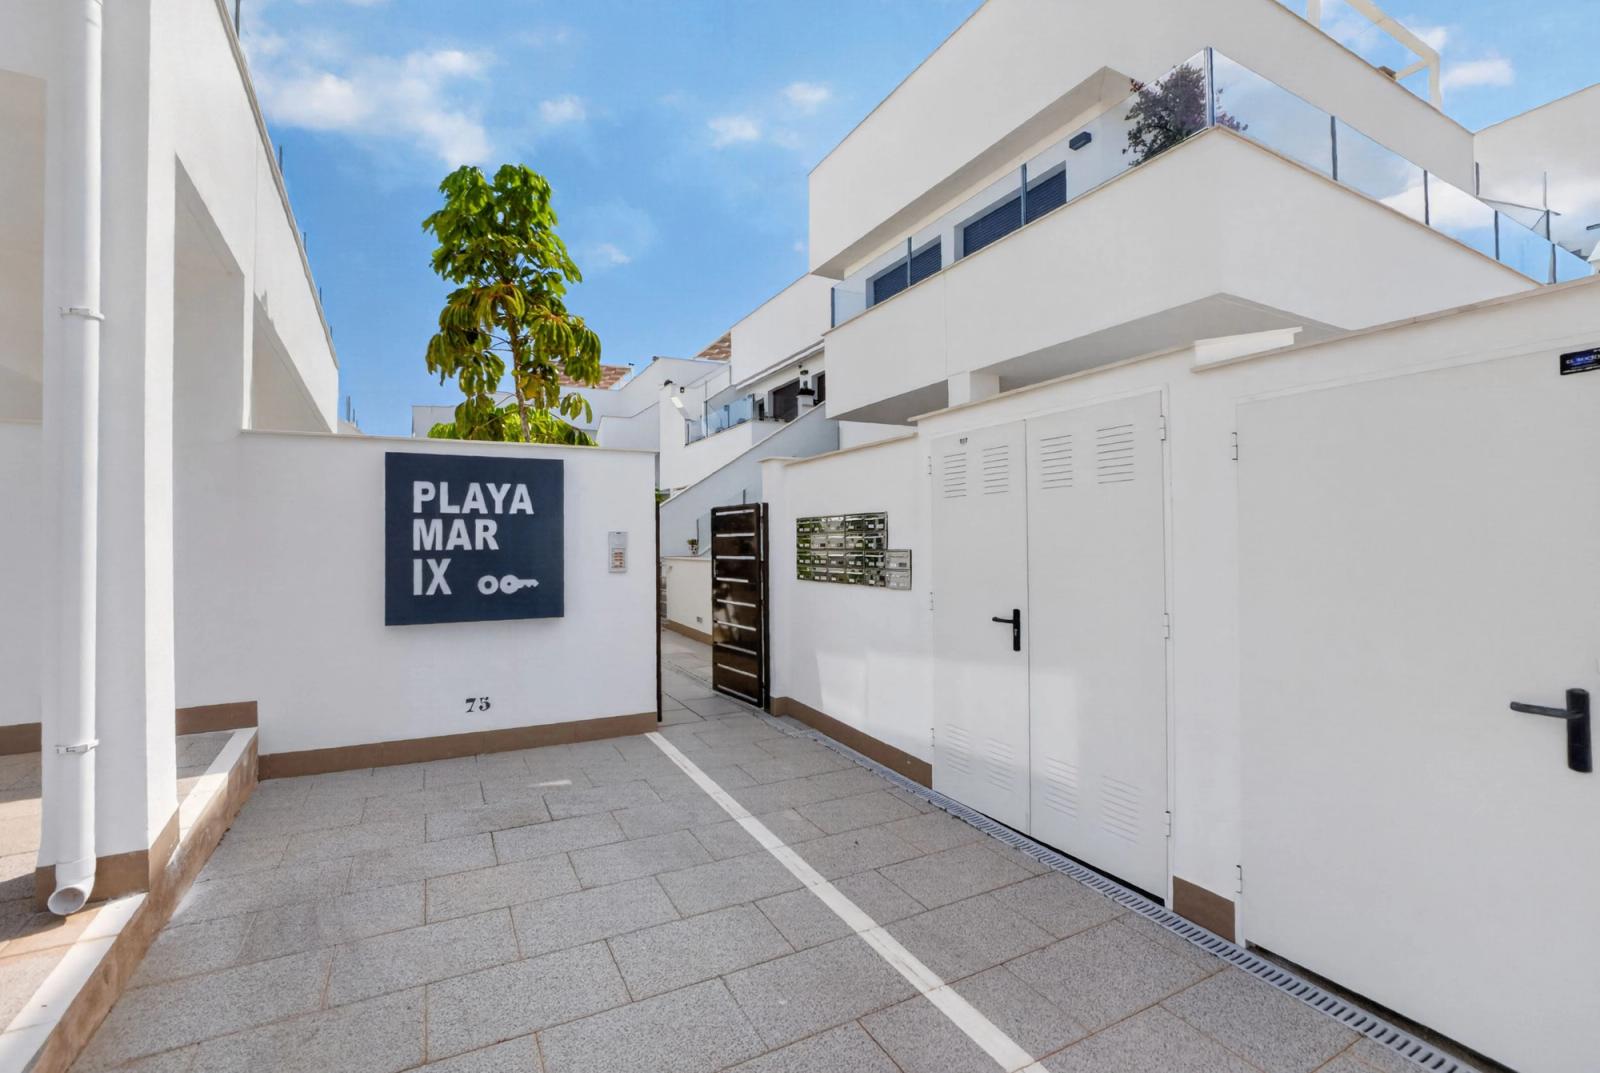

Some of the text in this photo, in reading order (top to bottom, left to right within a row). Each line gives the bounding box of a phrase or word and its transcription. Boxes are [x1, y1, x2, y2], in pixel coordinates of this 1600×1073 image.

[413, 481, 535, 515] PLAYA
[413, 518, 500, 551] MAR
[413, 558, 452, 596] IX
[465, 696, 490, 713] 75
